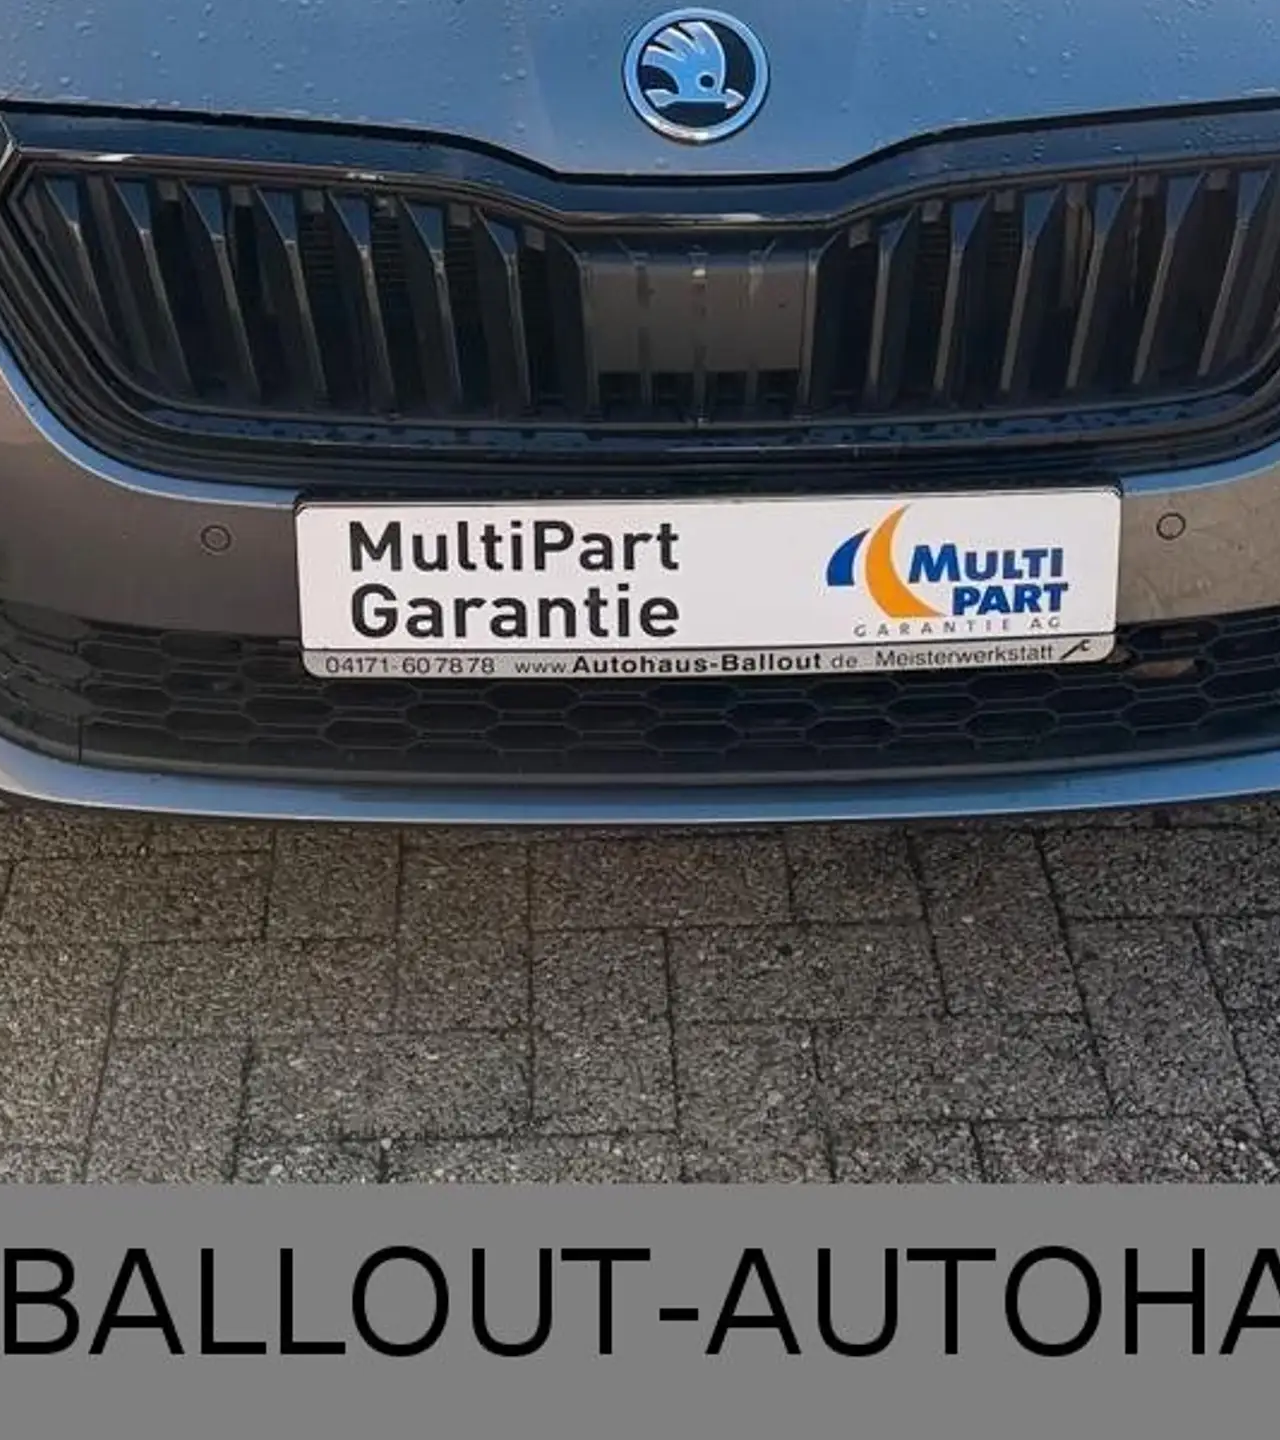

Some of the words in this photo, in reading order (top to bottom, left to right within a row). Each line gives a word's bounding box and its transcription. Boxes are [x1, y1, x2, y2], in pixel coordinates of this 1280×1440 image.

[349, 520, 680, 571] MultiPart
[908, 543, 1064, 583] MULTI
[351, 582, 680, 638] Garantie
[952, 582, 1069, 616] PART
[853, 618, 1011, 637] GARANTIE
[1029, 616, 1062, 629] AG
[875, 645, 1053, 667] Meisterwerkstatt
